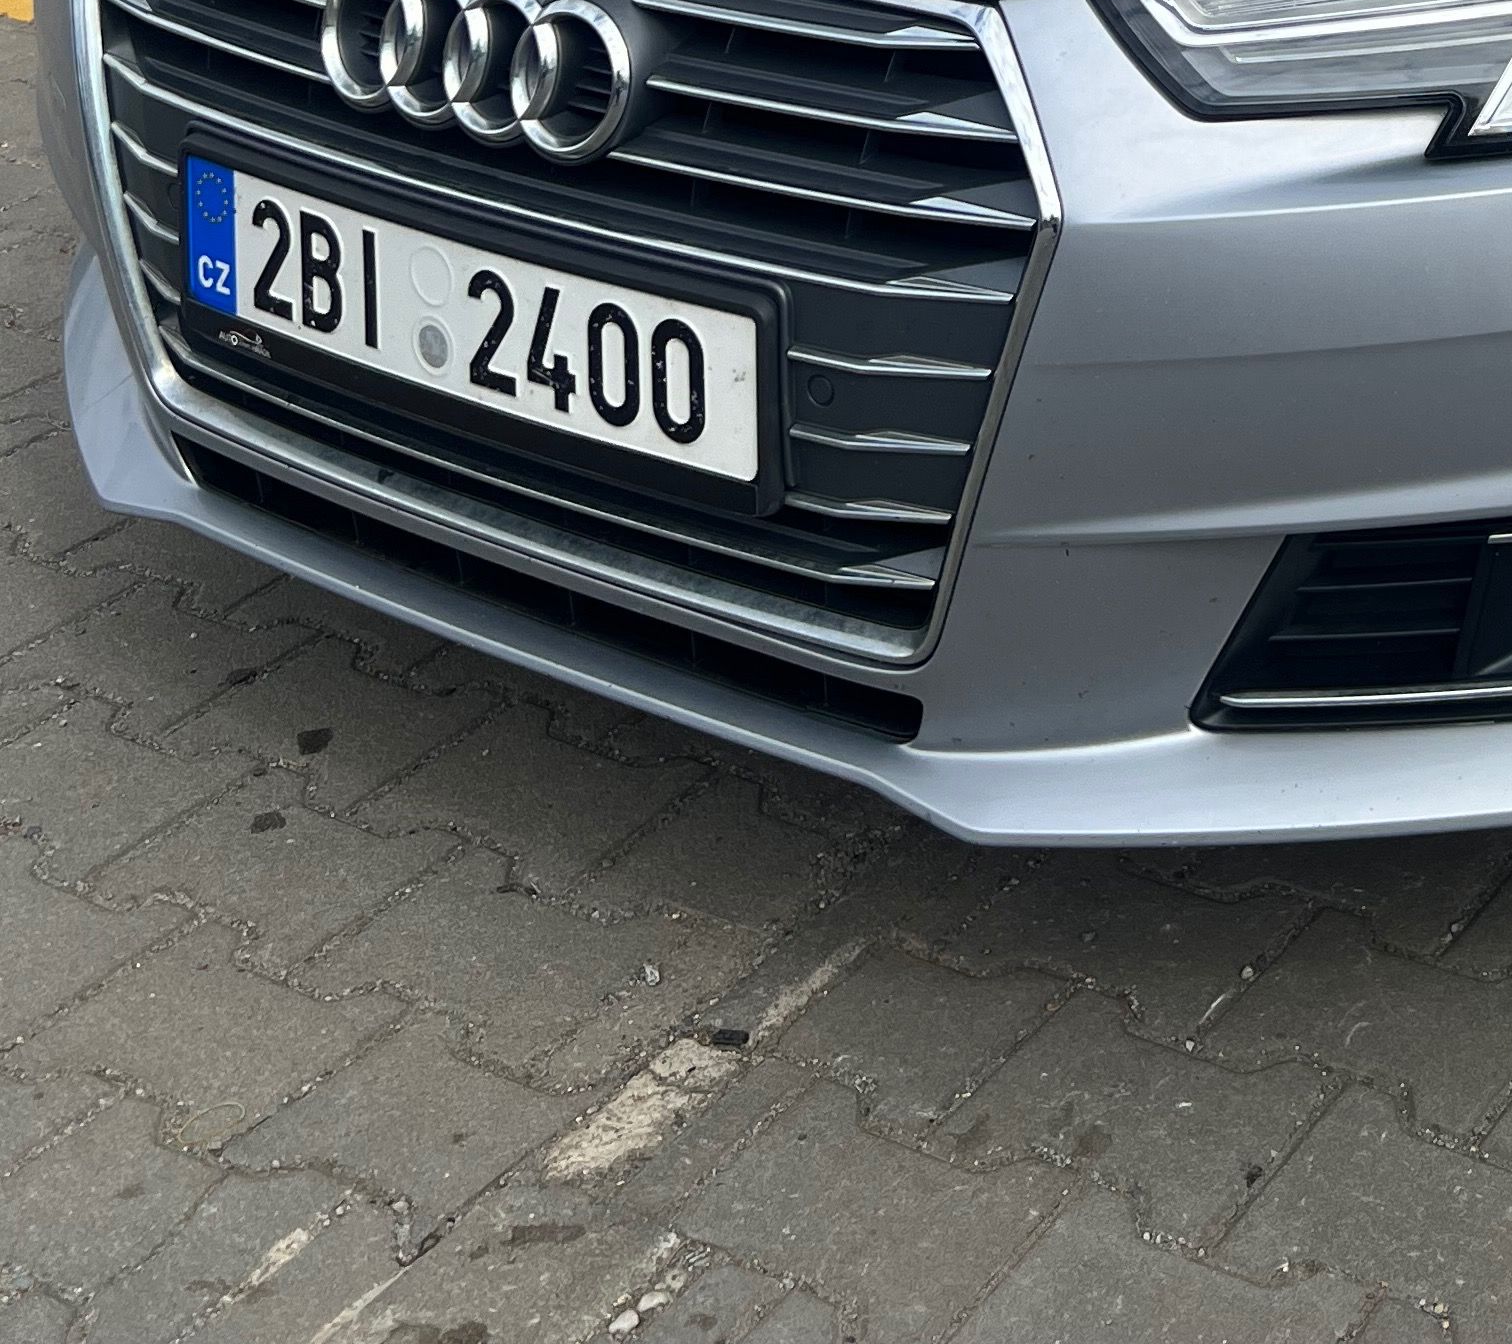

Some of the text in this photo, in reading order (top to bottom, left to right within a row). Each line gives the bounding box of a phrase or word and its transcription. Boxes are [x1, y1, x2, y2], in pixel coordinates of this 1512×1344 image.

[197, 254, 231, 296] CZ
[252, 198, 706, 445] 2BI 2400
